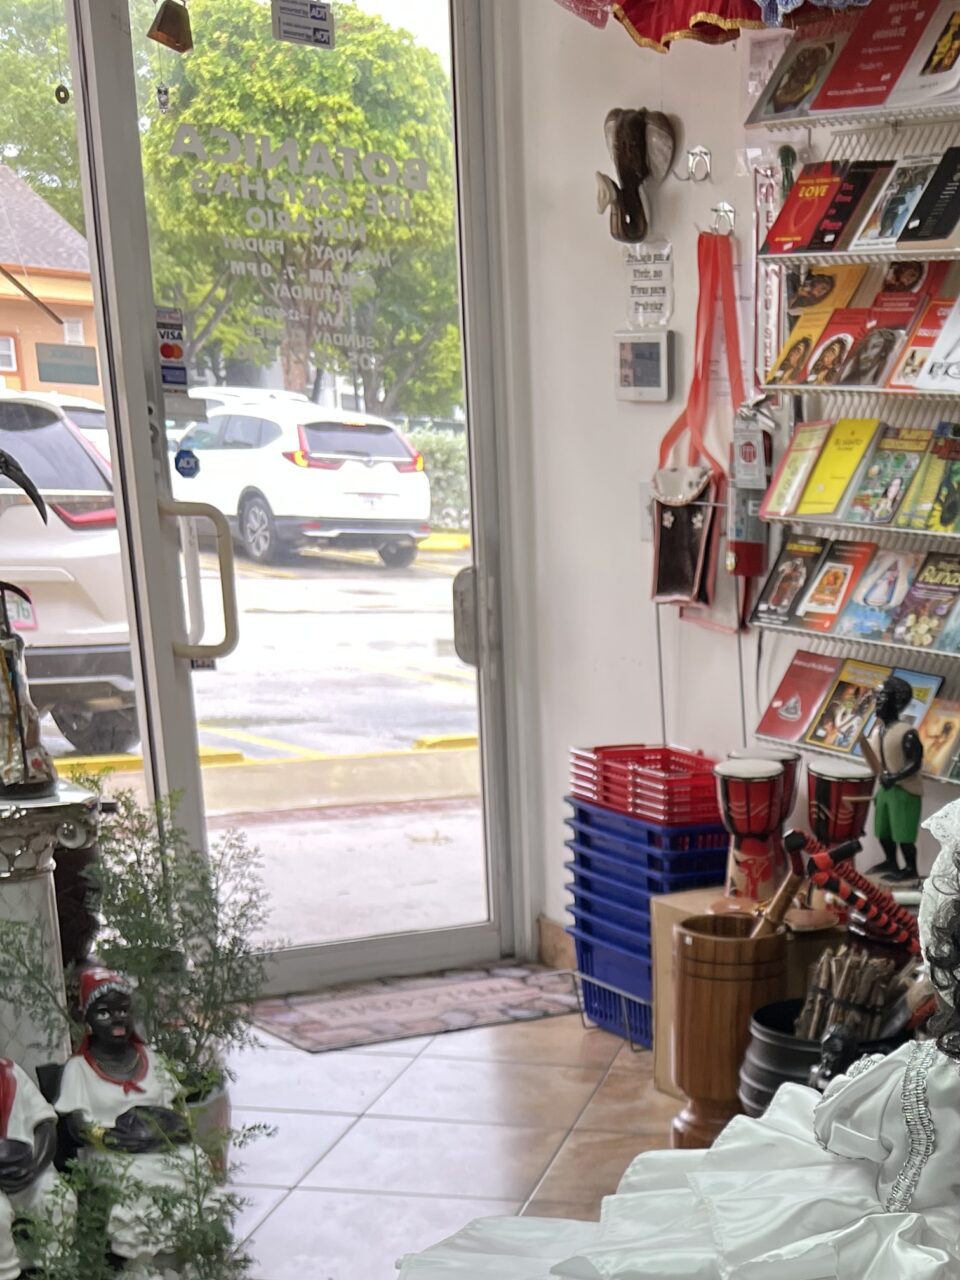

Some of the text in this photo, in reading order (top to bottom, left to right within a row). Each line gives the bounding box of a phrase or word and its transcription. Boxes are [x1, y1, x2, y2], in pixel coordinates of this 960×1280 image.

[798, 185, 829, 198] LOVE
[160, 331, 183, 341] VISA
[178, 457, 197, 469] ADT
